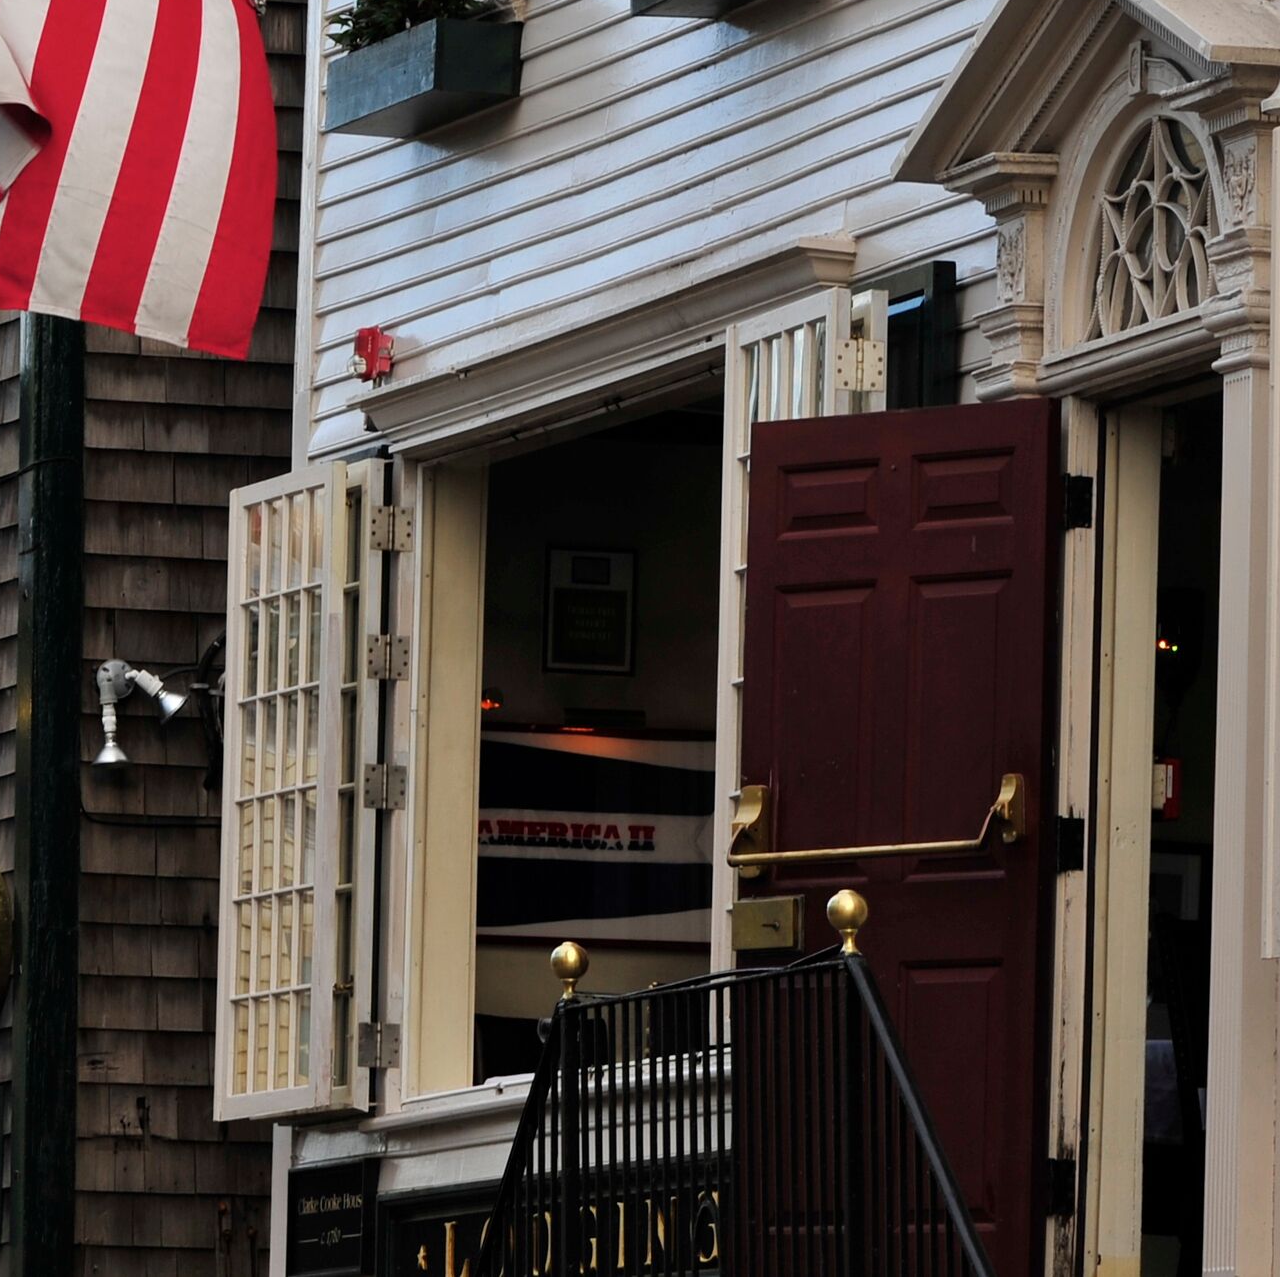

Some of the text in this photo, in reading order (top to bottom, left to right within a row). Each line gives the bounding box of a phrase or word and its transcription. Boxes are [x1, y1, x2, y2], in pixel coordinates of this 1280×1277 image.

[478, 819, 655, 851] AMERICA II
[298, 1193, 363, 1215] Clarke Cooke Hous
